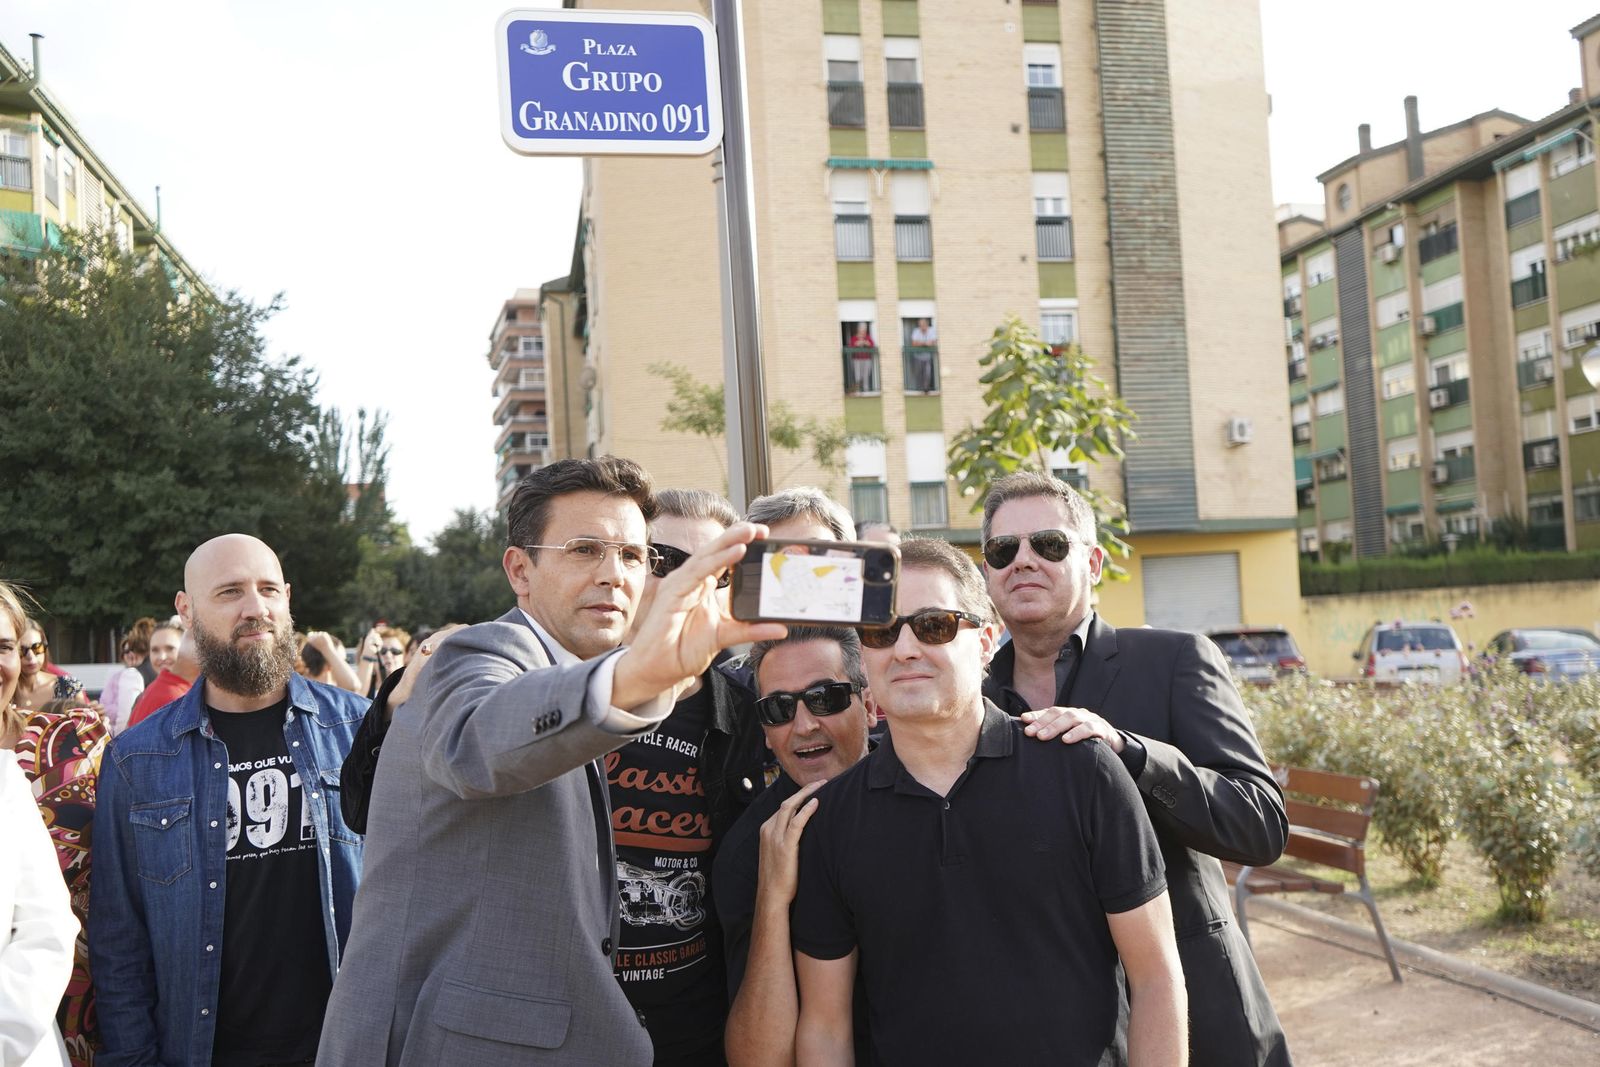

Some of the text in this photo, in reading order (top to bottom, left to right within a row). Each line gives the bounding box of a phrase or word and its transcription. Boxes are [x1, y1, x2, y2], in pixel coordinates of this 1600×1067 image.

[583, 39, 637, 56] PLAZA
[562, 61, 662, 93] GRUPO
[519, 101, 706, 133] GRANADINO 091
[665, 736, 698, 758] RACER
[254, 757, 276, 769] QUE
[654, 856, 683, 869] MOTOR
[635, 950, 677, 967] CLASSIC
[622, 967, 665, 982] VINTAGE
